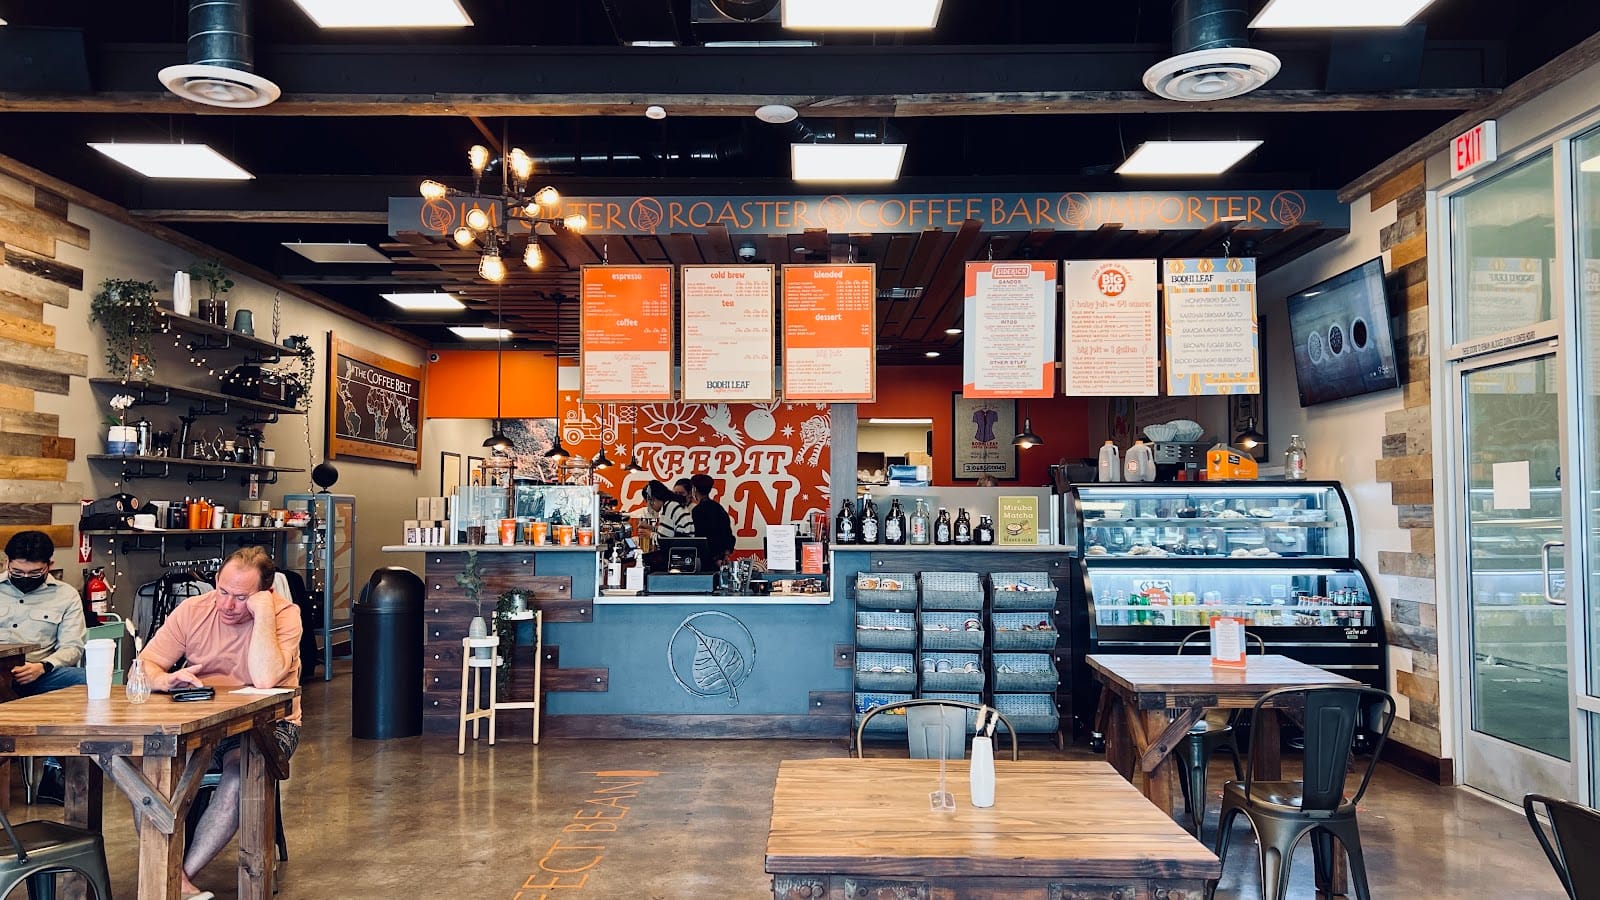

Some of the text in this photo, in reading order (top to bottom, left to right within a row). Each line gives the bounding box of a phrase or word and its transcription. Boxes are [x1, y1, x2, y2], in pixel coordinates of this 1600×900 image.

[1457, 127, 1481, 170] EXIT
[669, 200, 812, 228] ROASTER
[857, 198, 982, 227] COFFEE
[991, 197, 1055, 225] BAR
[1096, 196, 1267, 224] IMPORTER
[611, 273, 642, 282] espresso
[710, 271, 746, 279] cold brew
[813, 270, 843, 278] blended
[1195, 274, 1215, 282] LEAF
[1101, 284, 1125, 293] JOLT
[721, 299, 735, 307] tea
[815, 313, 842, 321] dessert
[616, 318, 639, 326] coffee
[354, 366, 412, 394] THE COFFEE BELT
[706, 380, 751, 389] BODHI LEAF
[636, 447, 786, 480] KEEP IT
[562, 780, 646, 833] BEAN
